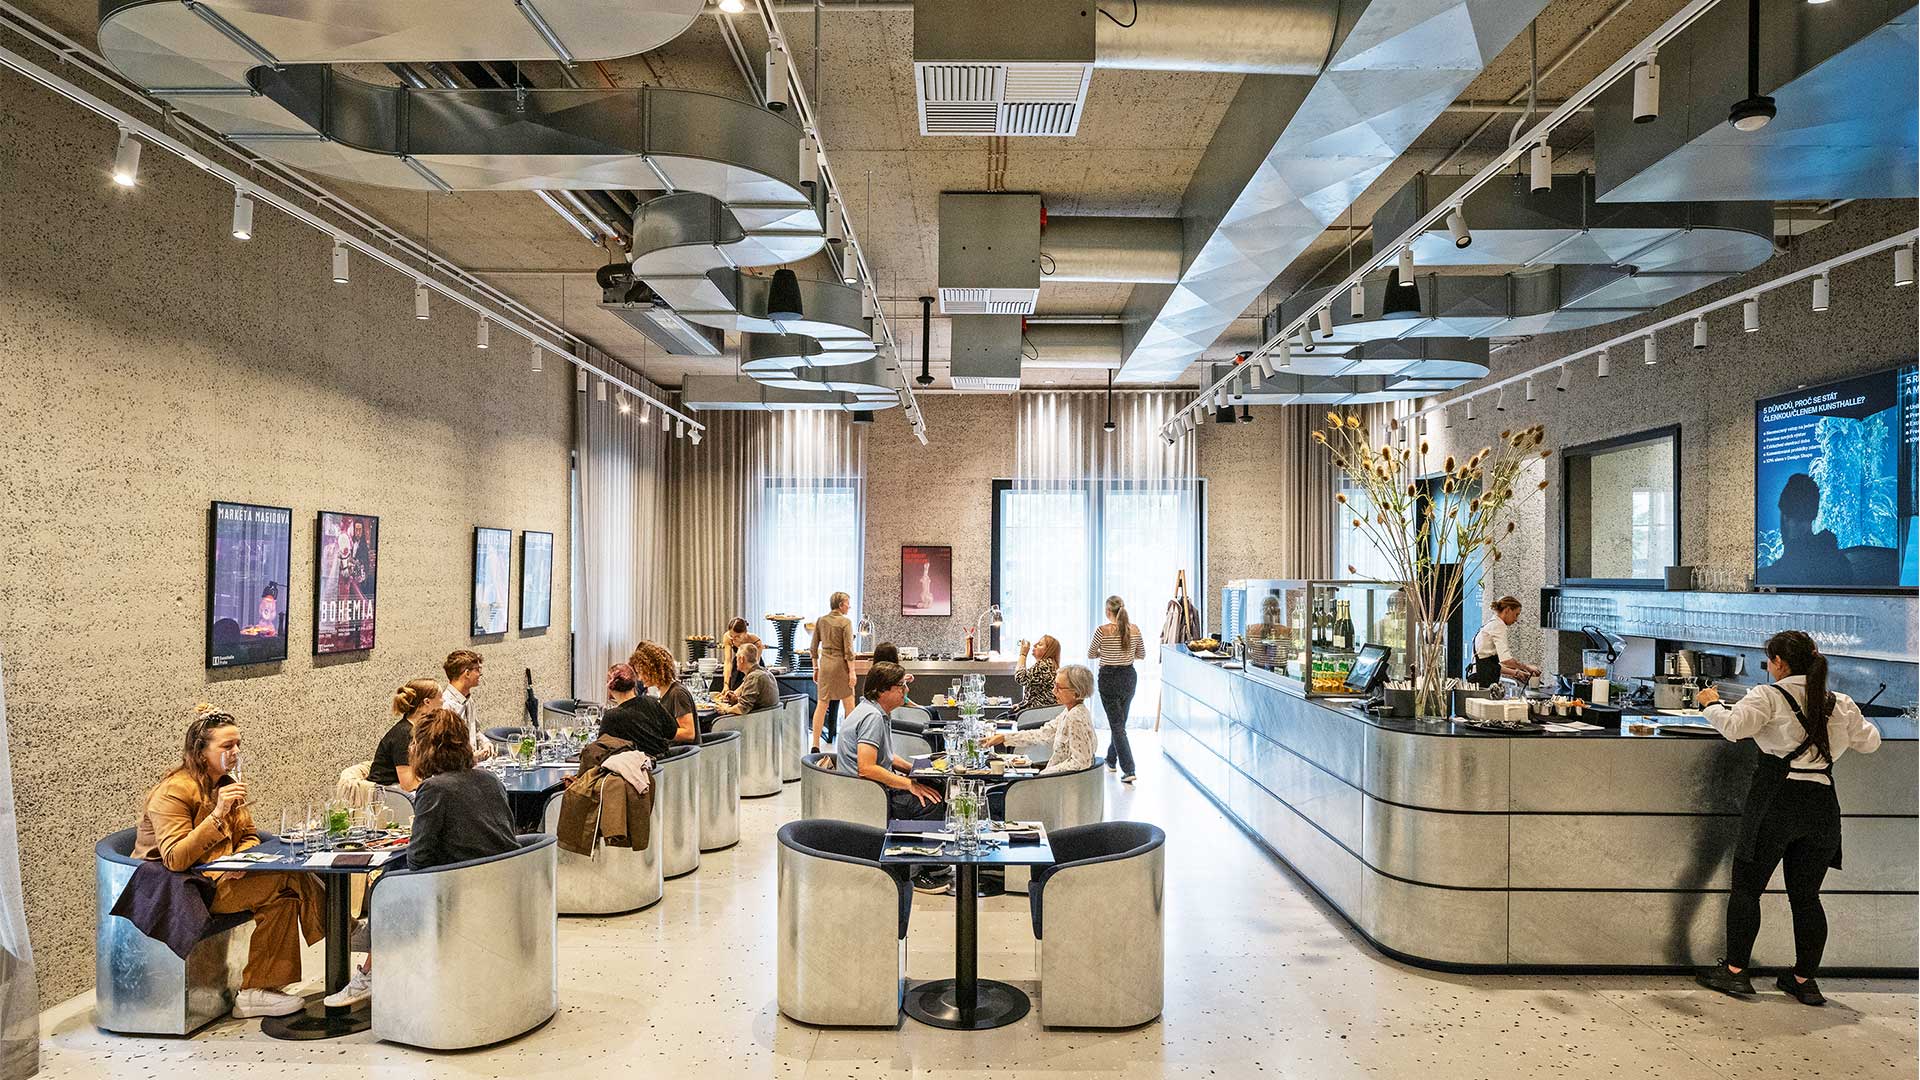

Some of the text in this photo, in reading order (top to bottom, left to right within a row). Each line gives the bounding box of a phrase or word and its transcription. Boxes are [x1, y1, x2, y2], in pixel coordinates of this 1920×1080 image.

[1768, 400, 1794, 413] DŮVODŮ,
[1795, 396, 1812, 408] PROČ
[1813, 395, 1821, 404] SE
[1822, 391, 1838, 402] STÁT
[1819, 396, 1865, 413] KUNSTHALLE?
[218, 506, 290, 525] MARKÉTA MAGIDOVÁ
[320, 599, 374, 622] BOHEMIA
